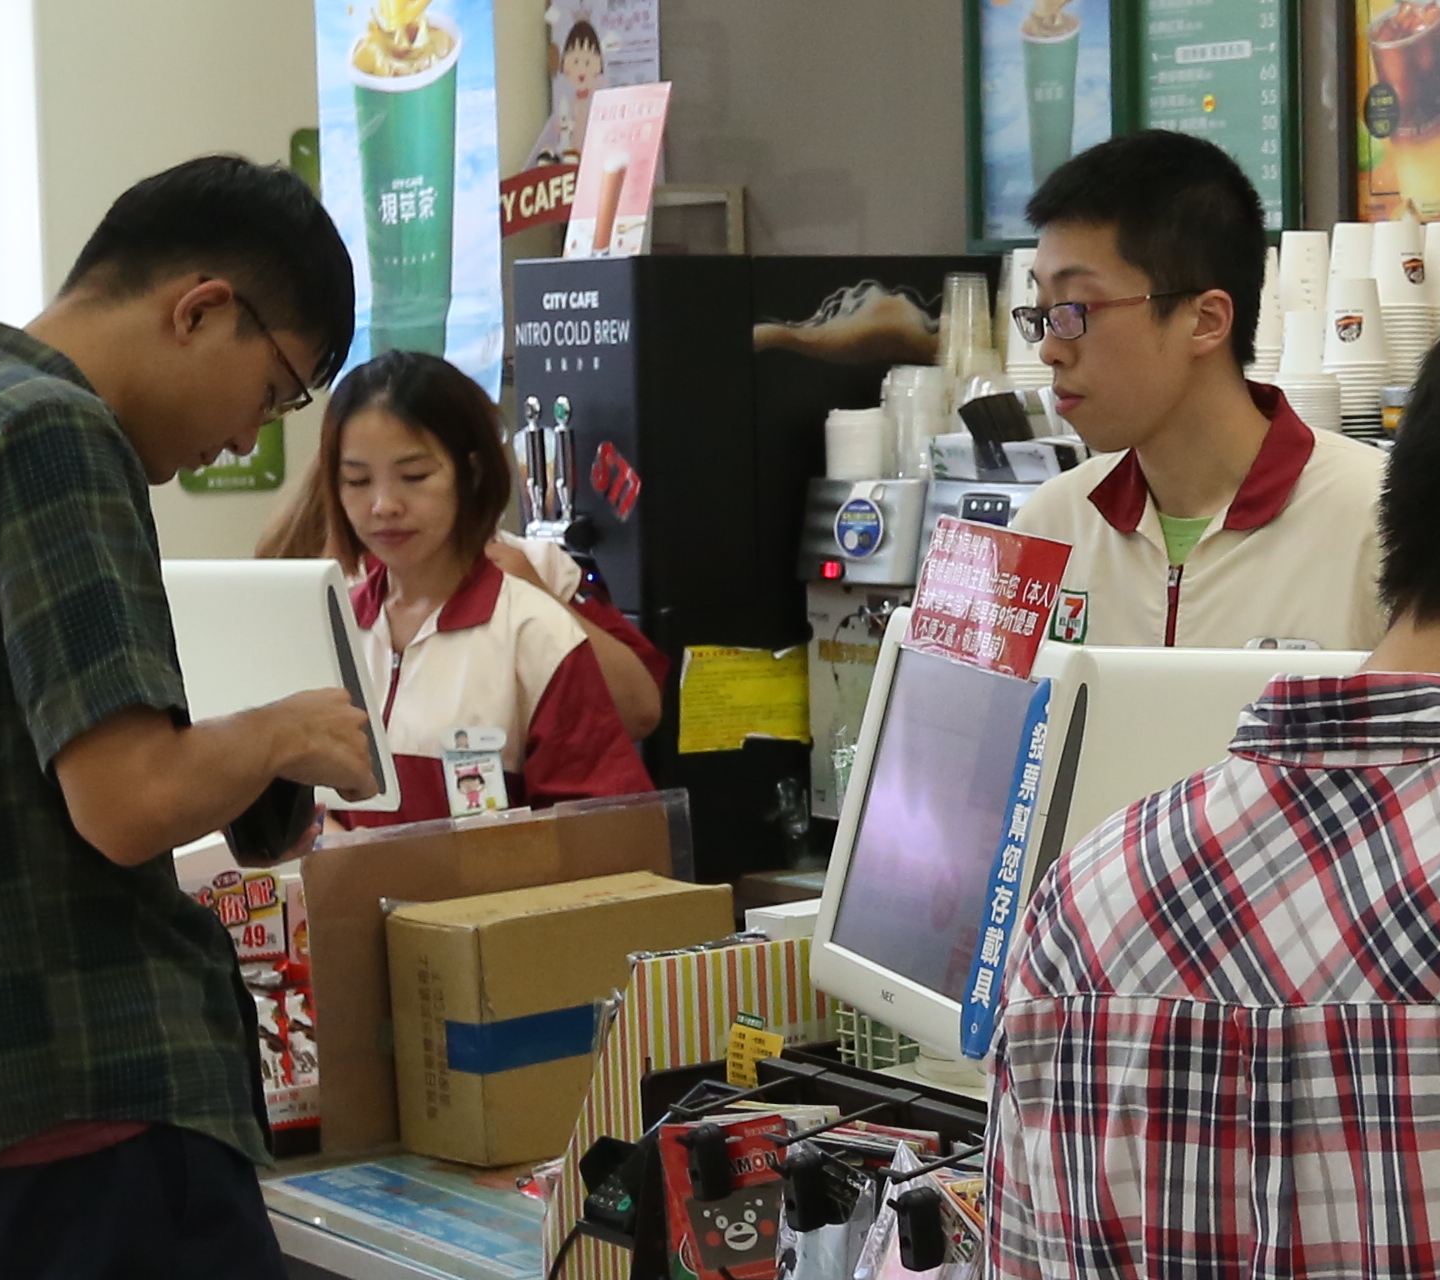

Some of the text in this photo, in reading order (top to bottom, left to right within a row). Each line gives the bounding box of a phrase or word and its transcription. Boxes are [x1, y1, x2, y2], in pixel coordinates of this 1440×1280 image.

[378, 186, 437, 224] 現萃茶
[519, 171, 576, 218] CAFE
[543, 290, 599, 310] CITY CAFE
[515, 318, 631, 347] NITRO COLD BREW
[1022, 578, 1059, 609] (本人)
[969, 722, 1049, 1009] 發票幫您存載具
[880, 988, 896, 1005] NEC
[731, 1149, 780, 1176] AMON
